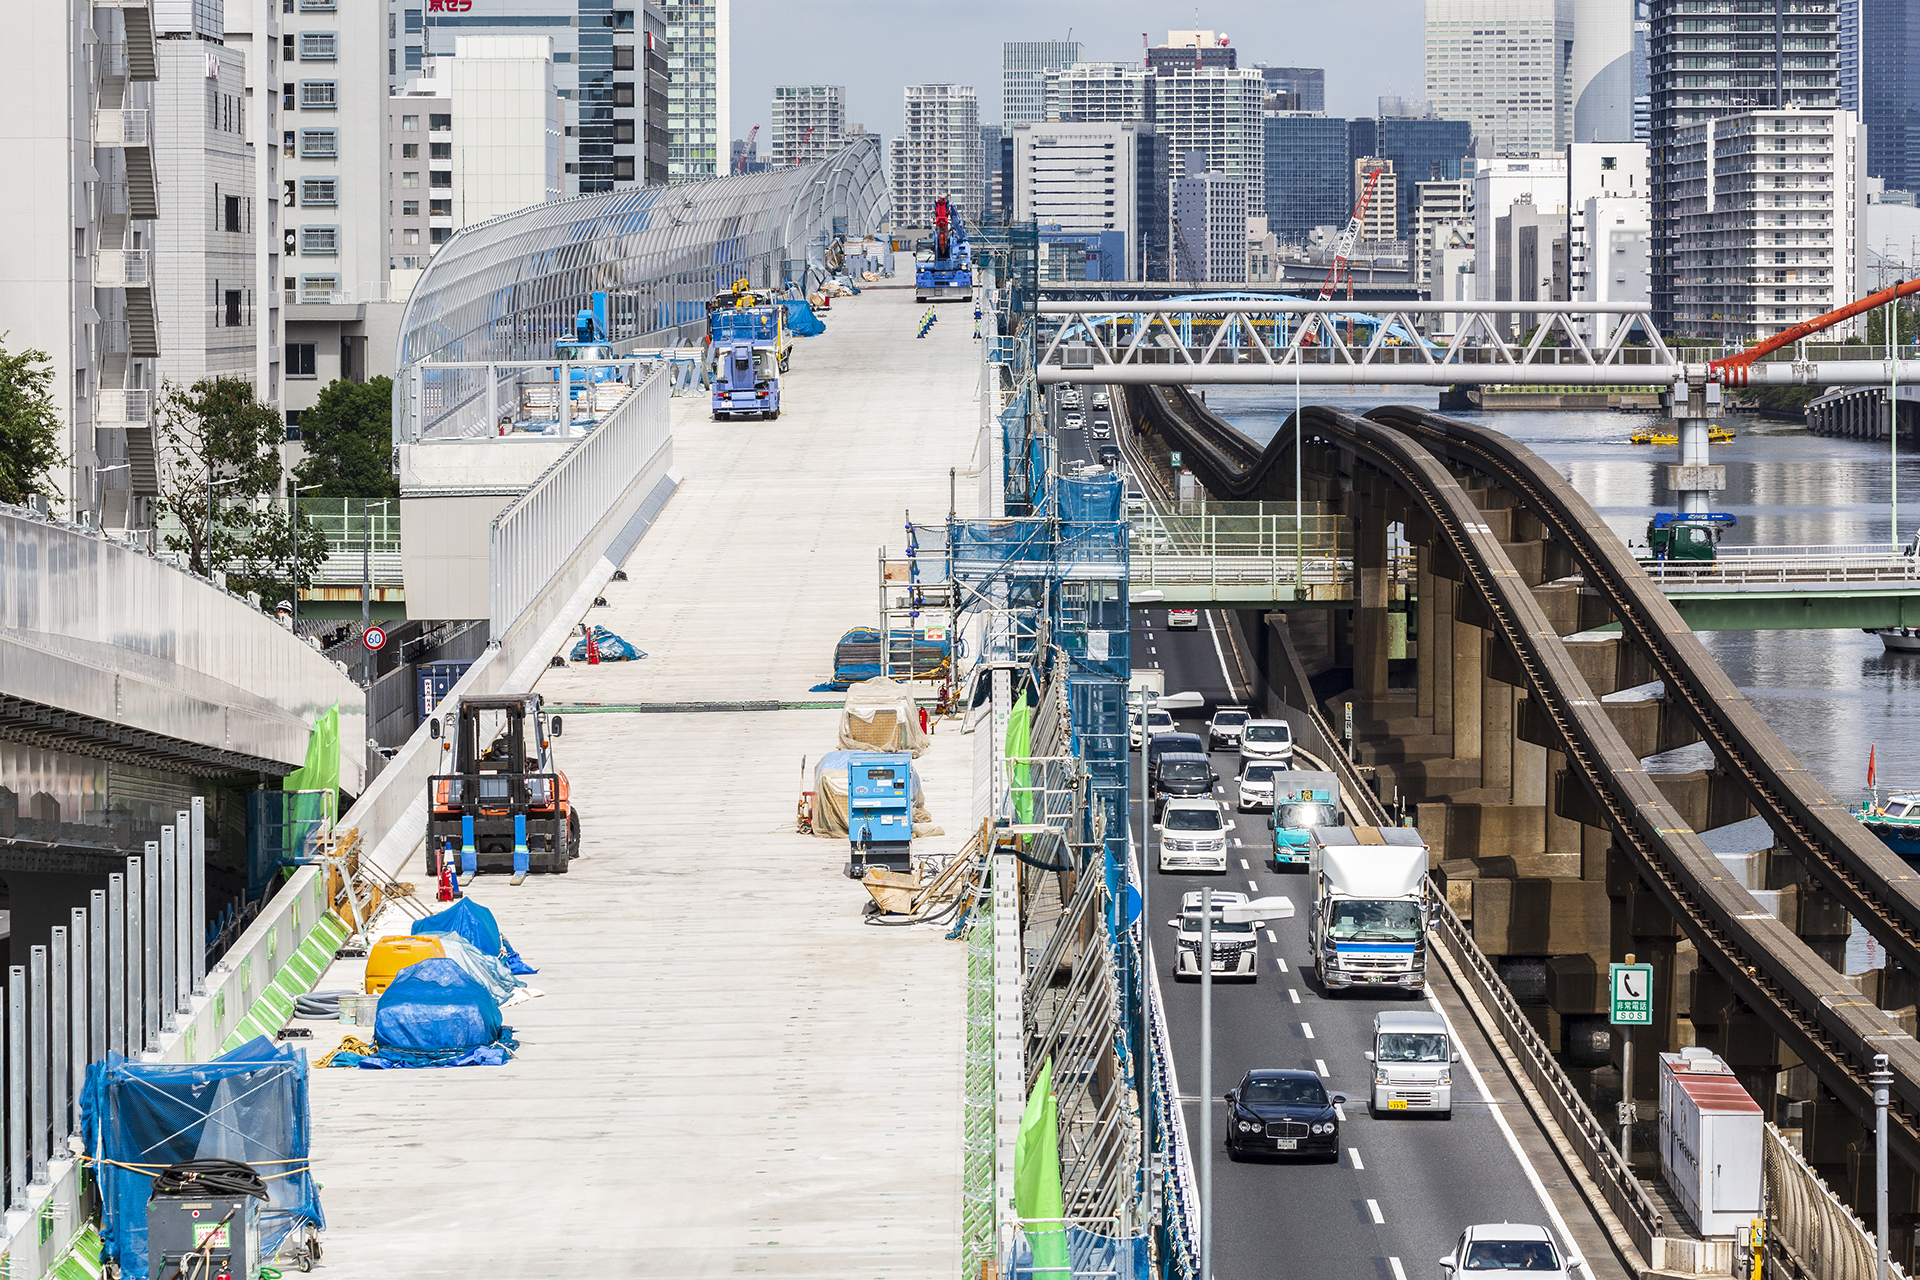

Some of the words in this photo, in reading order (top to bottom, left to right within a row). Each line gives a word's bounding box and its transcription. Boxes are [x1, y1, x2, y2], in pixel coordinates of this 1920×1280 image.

[368, 633, 381, 644] 60
[1616, 1001, 1647, 1010] 非常電話
[1620, 1012, 1643, 1020] SOS
